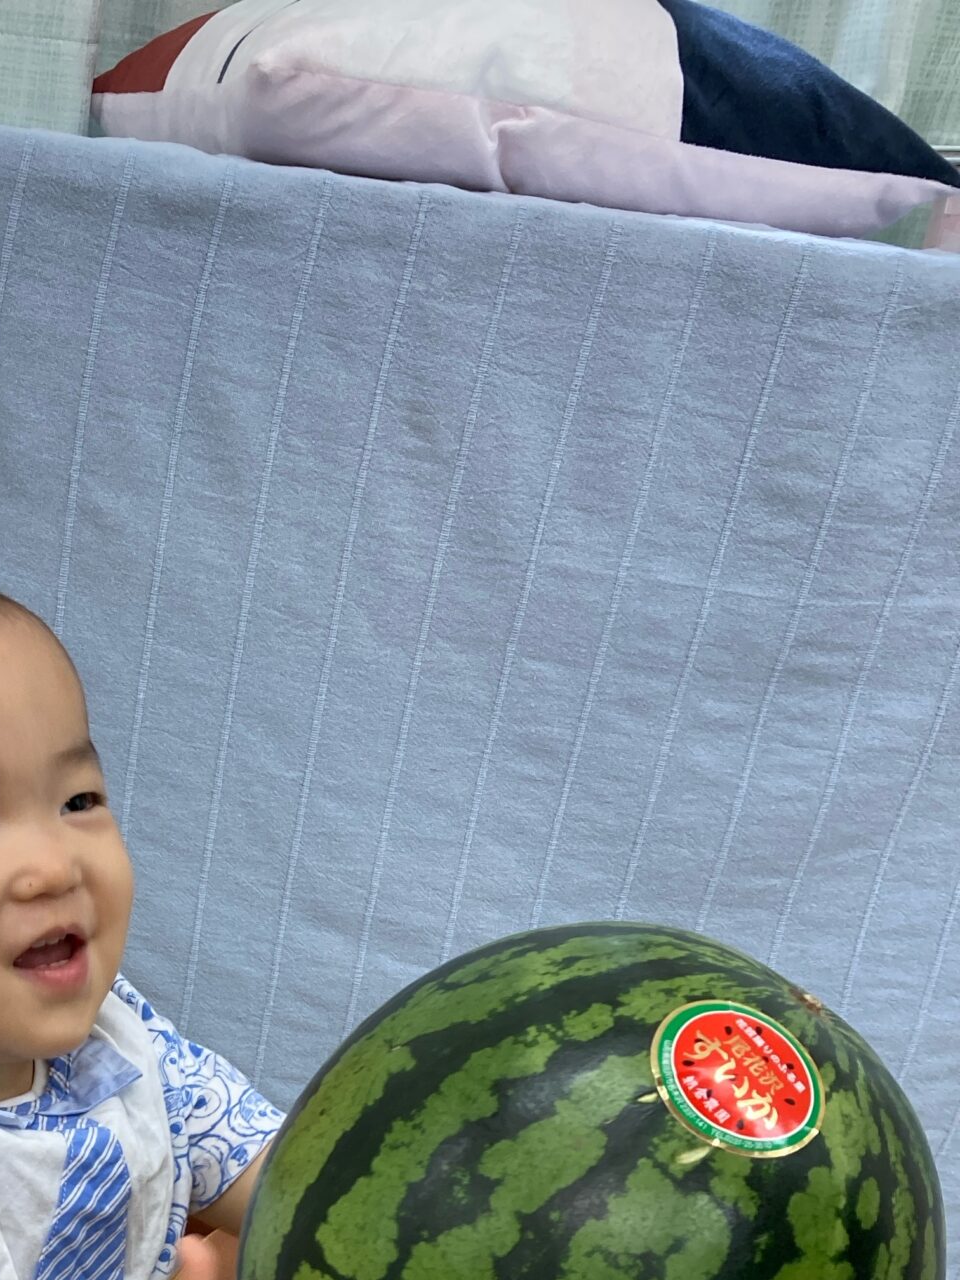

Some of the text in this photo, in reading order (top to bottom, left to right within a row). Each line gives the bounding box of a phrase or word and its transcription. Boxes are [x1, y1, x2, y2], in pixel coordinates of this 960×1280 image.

[682, 1029, 779, 1131] すいか
[723, 1034, 785, 1096] 尾花沢
